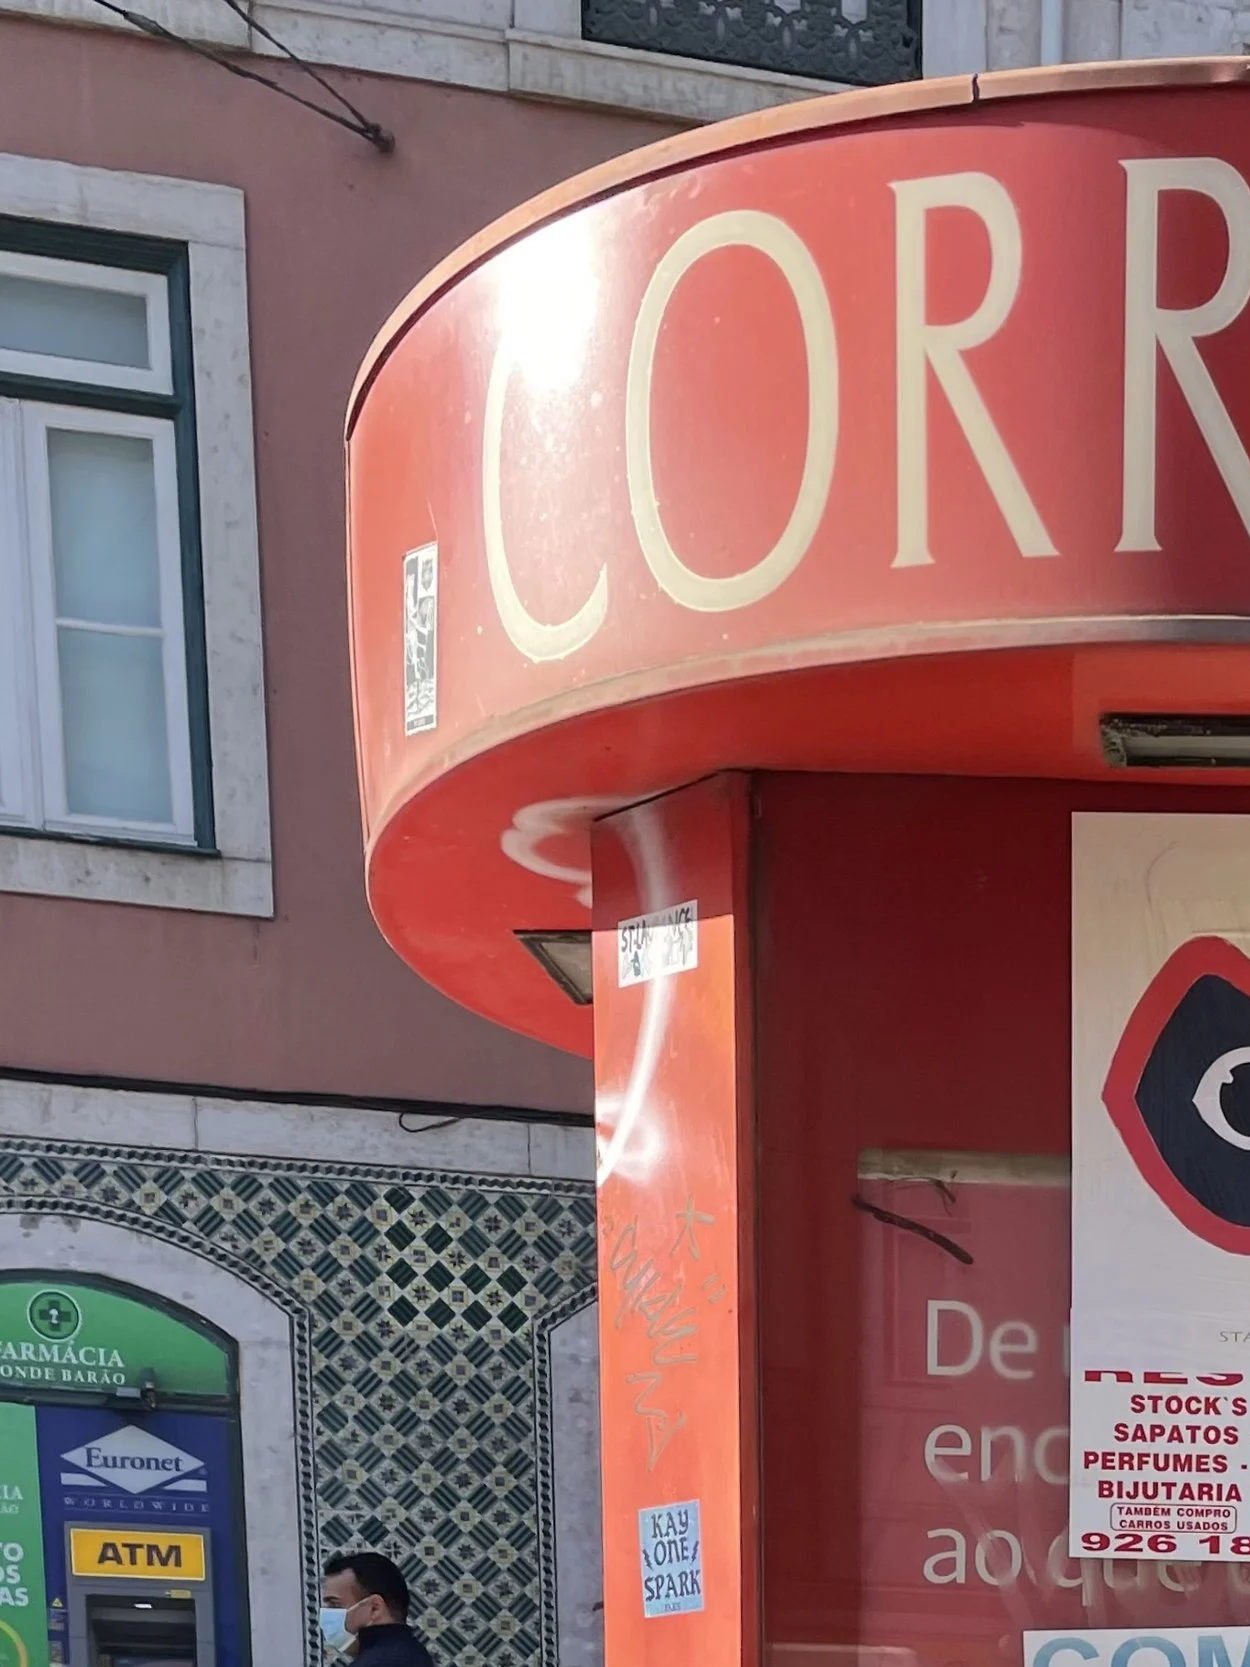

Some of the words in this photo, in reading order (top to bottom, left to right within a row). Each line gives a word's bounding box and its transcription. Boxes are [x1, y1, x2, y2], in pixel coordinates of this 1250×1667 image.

[926, 1300, 1038, 1380] De
[0, 1340, 125, 1368] ARMÁCIA
[62, 1368, 126, 1385] BARÃO
[1113, 1423, 1240, 1445] SAPATOS
[85, 1447, 183, 1472] Euronet
[1083, 1451, 1229, 1474] PERFUMES
[1098, 1480, 1243, 1503] BIJUTARIA
[64, 1496, 210, 1513] WORLDWIDE
[1117, 1504, 1172, 1518] TAMBÉM
[1176, 1507, 1232, 1519] COMPRO
[651, 1509, 689, 1539] KAY
[1119, 1519, 1172, 1531] CARROS
[1177, 1520, 1229, 1532] USADOS
[97, 1541, 183, 1568] ATM
[653, 1537, 690, 1567] ONE
[1080, 1532, 1179, 1554] 926
[923, 1528, 1023, 1586] ao
[644, 1569, 702, 1602] SPARK
